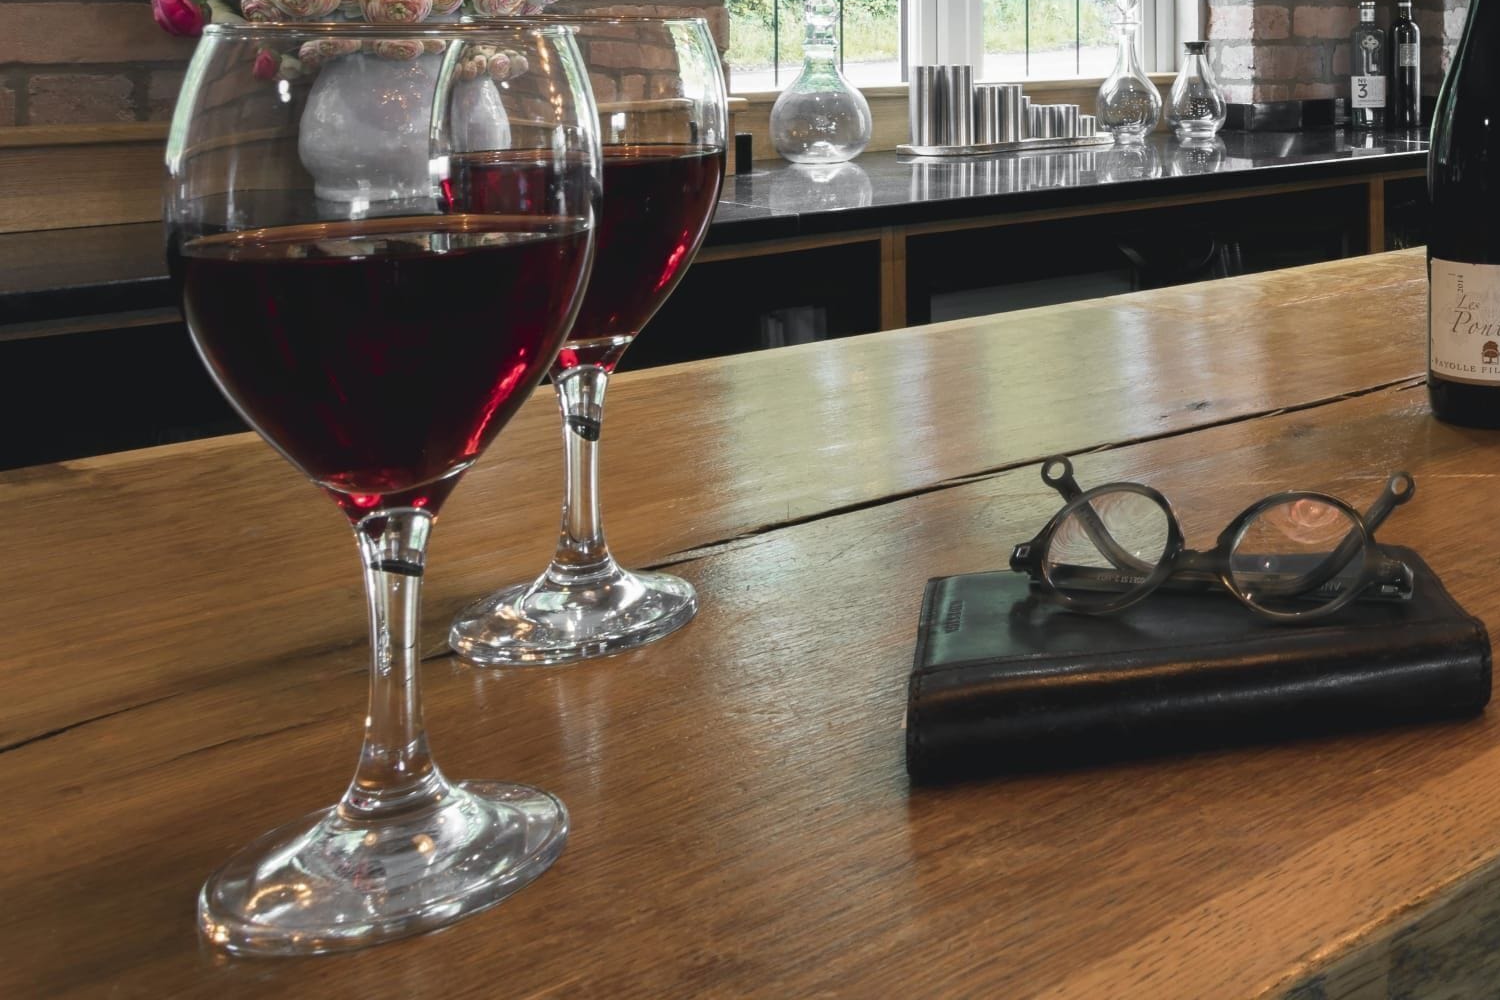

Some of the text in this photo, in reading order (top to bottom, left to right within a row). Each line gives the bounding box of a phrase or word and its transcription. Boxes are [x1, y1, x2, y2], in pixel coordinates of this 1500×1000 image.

[1358, 84, 1368, 99] 3
[1456, 294, 1480, 310] Les
[1434, 356, 1477, 373] FAYOLLE
